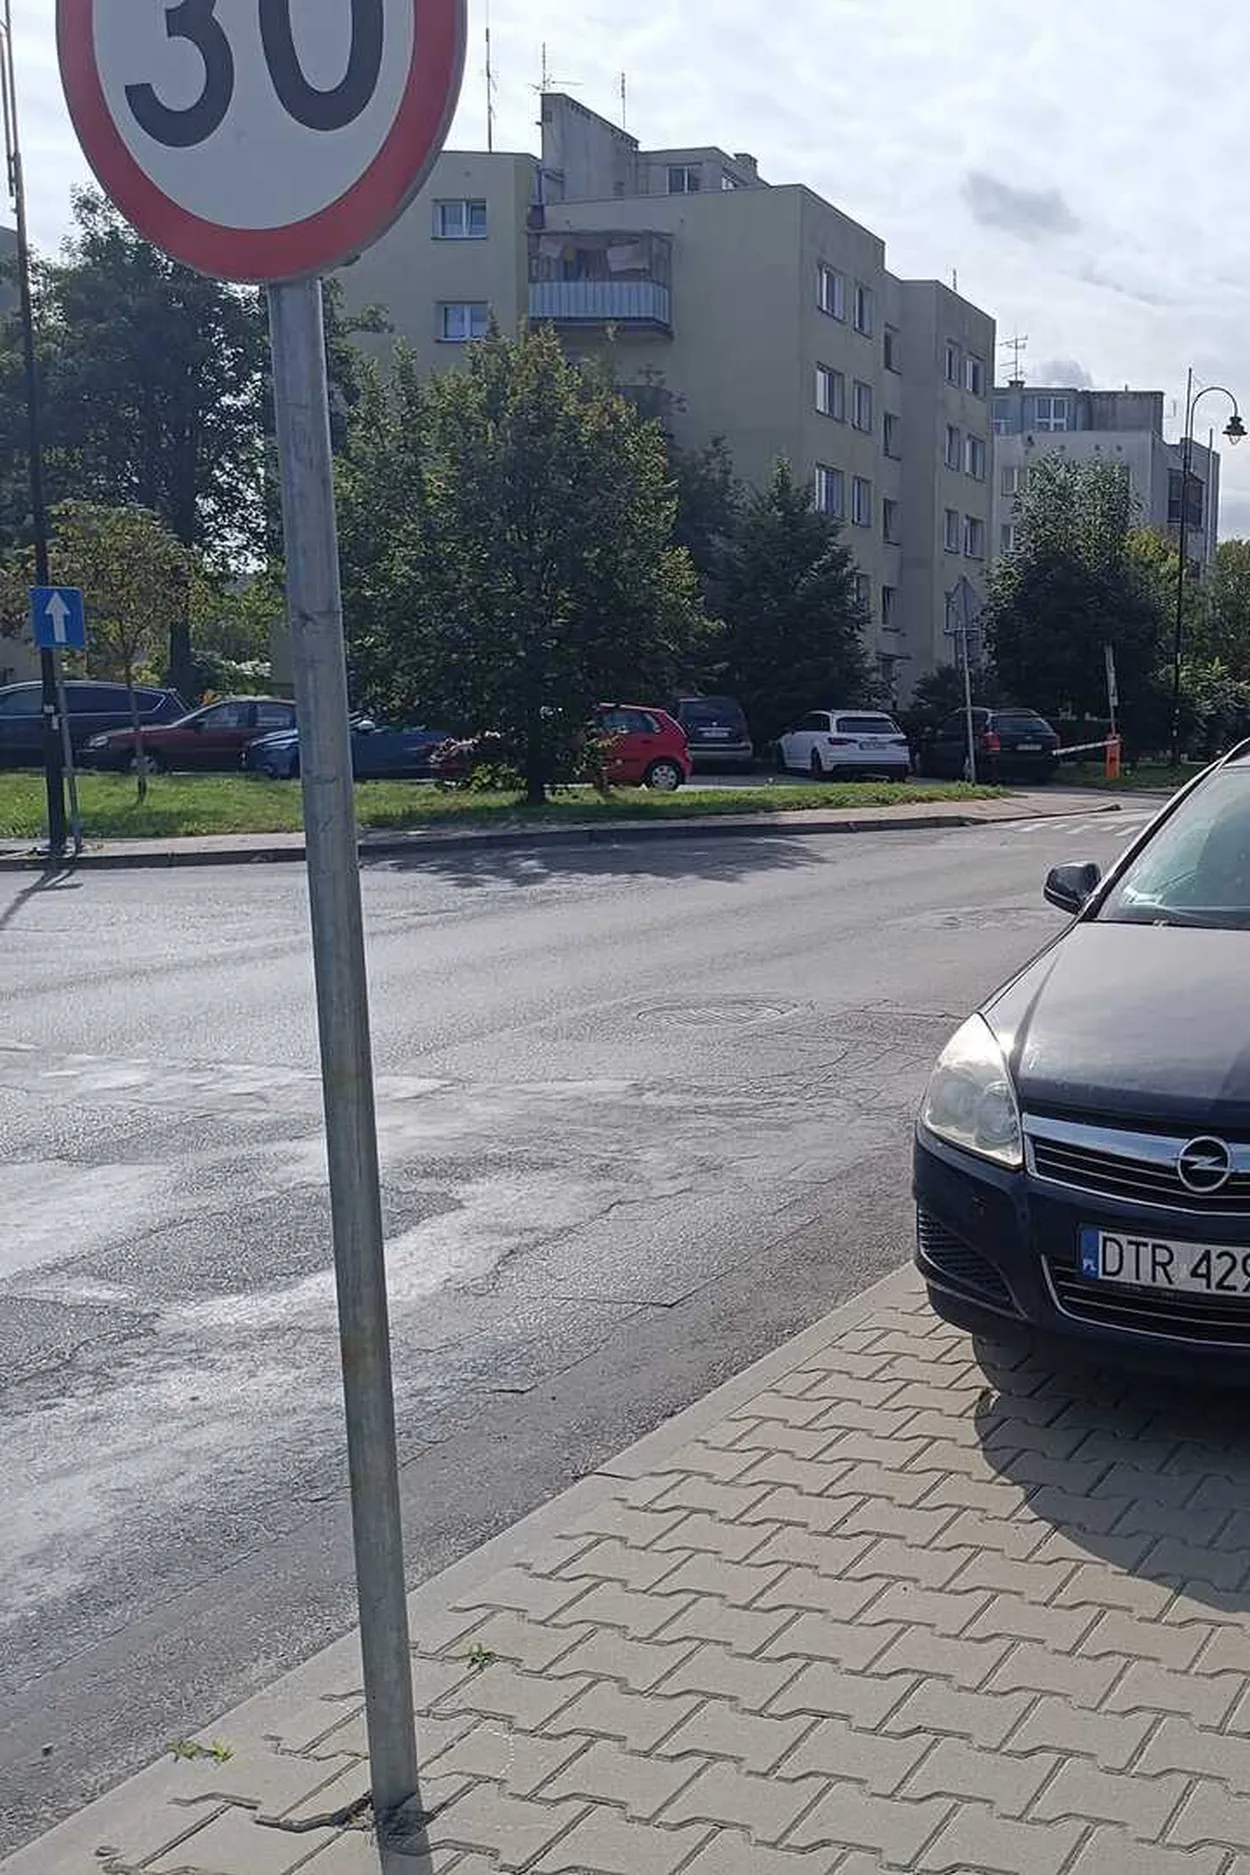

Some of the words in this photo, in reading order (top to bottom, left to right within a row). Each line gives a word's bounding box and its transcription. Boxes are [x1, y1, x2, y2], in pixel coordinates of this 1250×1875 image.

[125, 0, 384, 148] 30
[1083, 1258, 1097, 1272] PL
[1102, 1236, 1174, 1285] DTR
